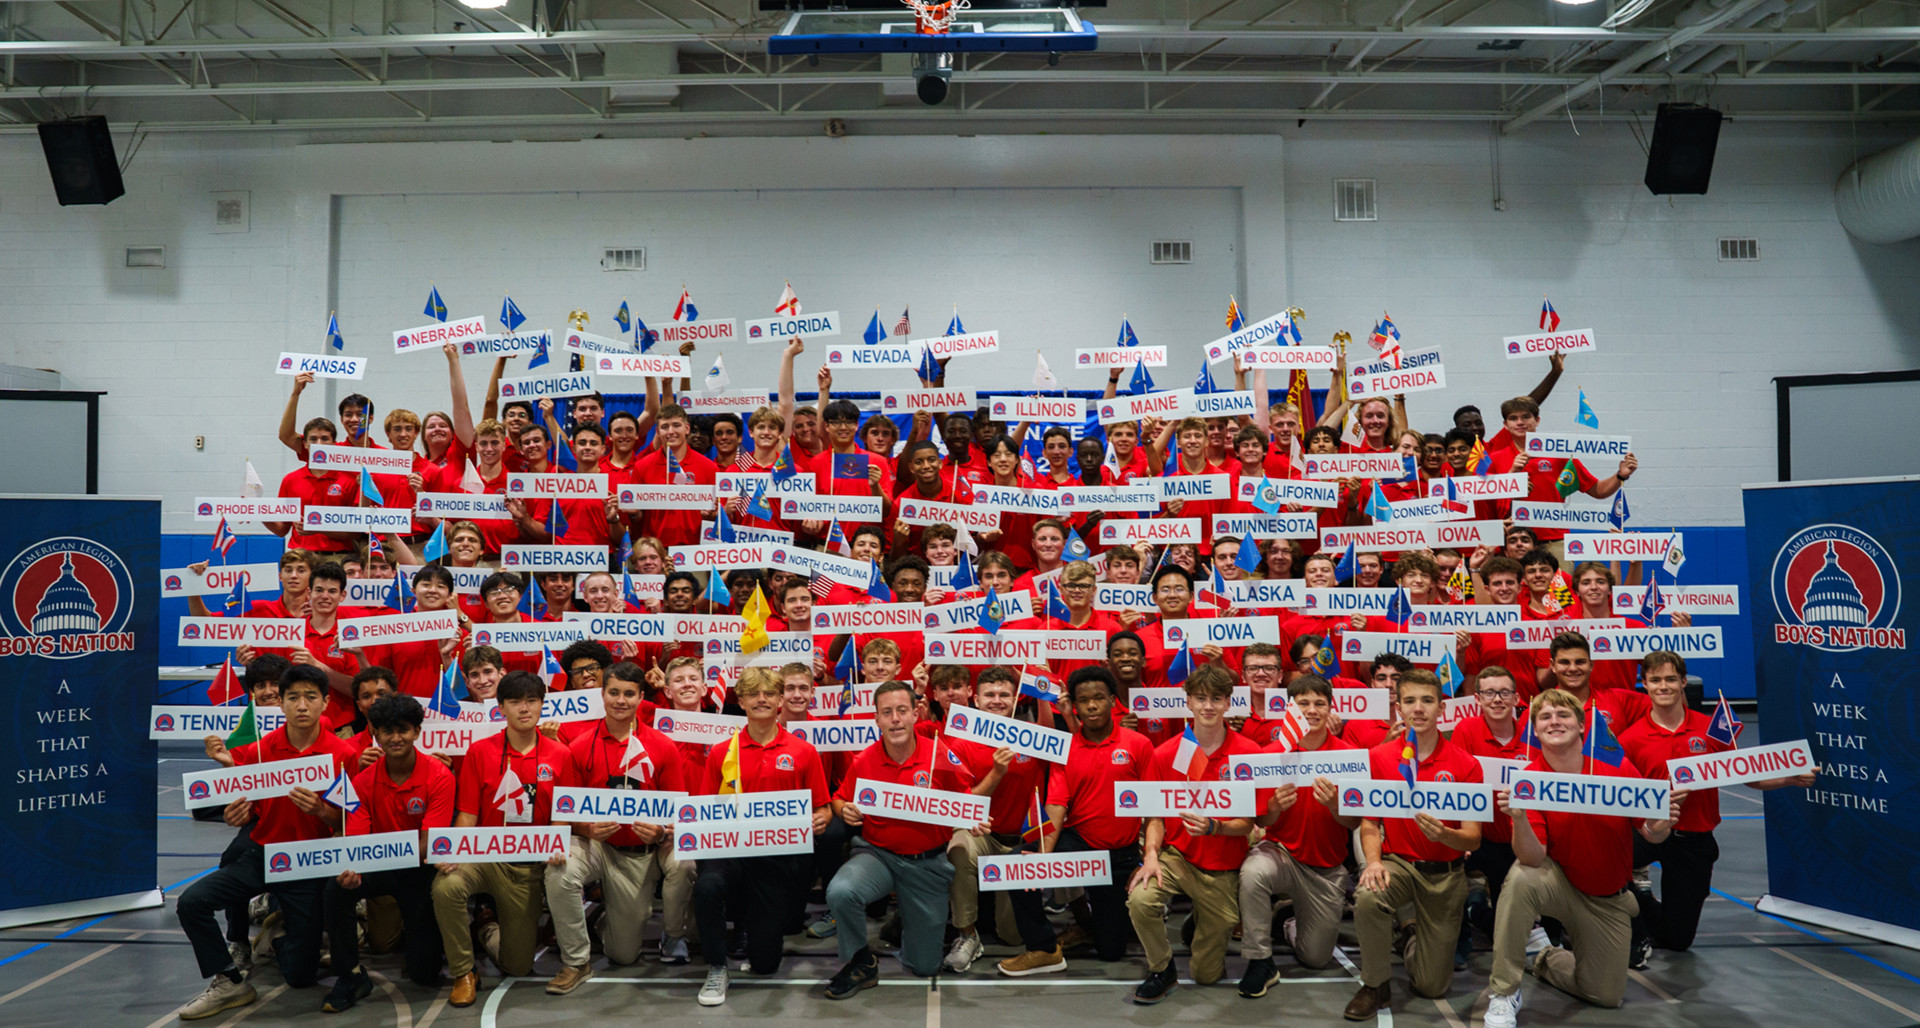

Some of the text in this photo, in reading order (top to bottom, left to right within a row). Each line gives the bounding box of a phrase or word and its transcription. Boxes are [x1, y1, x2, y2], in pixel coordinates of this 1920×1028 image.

[411, 321, 484, 346] NEBRASKA
[664, 324, 733, 342] MISSOURI
[770, 319, 832, 336] FLORIDA
[1526, 335, 1589, 352] GEORGIA
[852, 350, 911, 363] NEVADA
[1094, 350, 1163, 364] MICHIGAN
[1261, 351, 1333, 364] COLORADO
[300, 357, 356, 375] KANSAS
[621, 359, 681, 372] KANSAS
[518, 376, 591, 396] MICHIGAN
[1372, 371, 1436, 392] FLORIDA
[695, 395, 766, 407] MASSACHUSETTS
[907, 392, 966, 408] INDIANA
[1131, 395, 1179, 415] MAINE
[1198, 396, 1253, 412] UISIANA
[1016, 402, 1077, 417] ILLINOIS
[1545, 438, 1628, 454] DELAWARE
[328, 454, 411, 469] NEW HAMPSHIRE
[1320, 459, 1401, 473] CALIFORNIA
[535, 478, 597, 493] NEVADA
[773, 478, 812, 492] YORK
[1164, 480, 1212, 497] MAINE
[436, 500, 471, 511] RHODE
[636, 492, 713, 502] NORTH CAROLINA
[991, 493, 1059, 509] ARKANSA
[1078, 494, 1155, 505] MASSACHUSETTS
[216, 505, 297, 515] RHODE ISLAND
[800, 502, 881, 515] NORTH DAKOTA
[324, 513, 409, 525] SOUTH DAKOTA
[917, 510, 997, 527] ARKANSAS
[1231, 518, 1315, 534] MINNESOTA
[1127, 523, 1191, 538] ALASKA
[1339, 531, 1426, 546] MINNESOTA
[1437, 526, 1481, 542] IOWA
[1788, 529, 1879, 558] AMERICAN LEGION
[20, 542, 116, 569] AMERICAN LEGION
[522, 551, 606, 566] NEBRASKA
[694, 548, 763, 565] OREGON
[788, 554, 820, 570] NORTH
[821, 560, 868, 580] CAROLINA
[206, 571, 251, 589] OHIO
[1230, 583, 1295, 602] LASKA
[1676, 593, 1734, 605] VIRGINIA
[832, 609, 922, 626] WISCONSIN
[1429, 611, 1518, 626] MARYLAND
[204, 624, 299, 641] NEW YORK
[363, 619, 453, 636] PENNSYLVANIA
[590, 619, 665, 636] OREGON
[1208, 623, 1255, 640] IOWA
[60, 632, 135, 652] NATION
[495, 631, 584, 644] PENNSYLVANIA
[1616, 634, 1716, 653] WYOMING
[1776, 624, 1906, 650] BOYS NATION
[950, 641, 1041, 658] VERMONT
[1387, 639, 1431, 656] UTAH
[57, 680, 71, 694] A
[1831, 672, 1845, 689] A
[541, 696, 589, 718] EXAS
[1331, 696, 1367, 713] AHO
[1813, 702, 1867, 720] WEEK
[37, 708, 92, 724] WEEK
[675, 721, 713, 733] DISTRICT
[716, 725, 726, 733] OF
[813, 727, 882, 744] MONTA
[37, 736, 90, 753] THAT
[422, 730, 473, 748] UTAH
[973, 717, 1065, 756] MISSOURI
[1816, 731, 1867, 749] THAT
[1254, 762, 1368, 777] DISTRICT OF COLUMBIA
[1697, 748, 1807, 781] WYOMING
[1818, 761, 1888, 783] HAPES A
[17, 763, 109, 784] SHAPES A
[213, 765, 329, 795] WASHINGTON
[18, 791, 106, 812] LIFETIME
[1161, 789, 1231, 809] TEXAS
[1369, 790, 1487, 812] COLORADO
[1540, 781, 1667, 810] KENTUCKY
[1805, 788, 1888, 814] LIFETIME
[701, 799, 809, 821] NEW JERSEY
[882, 792, 984, 821] TENNESSEE
[456, 834, 566, 856] ALABAMA
[701, 827, 810, 849] NEW JERSEY
[297, 842, 414, 867] WEST VIRGINIA
[1006, 862, 1106, 881] MISSISSIPPI
